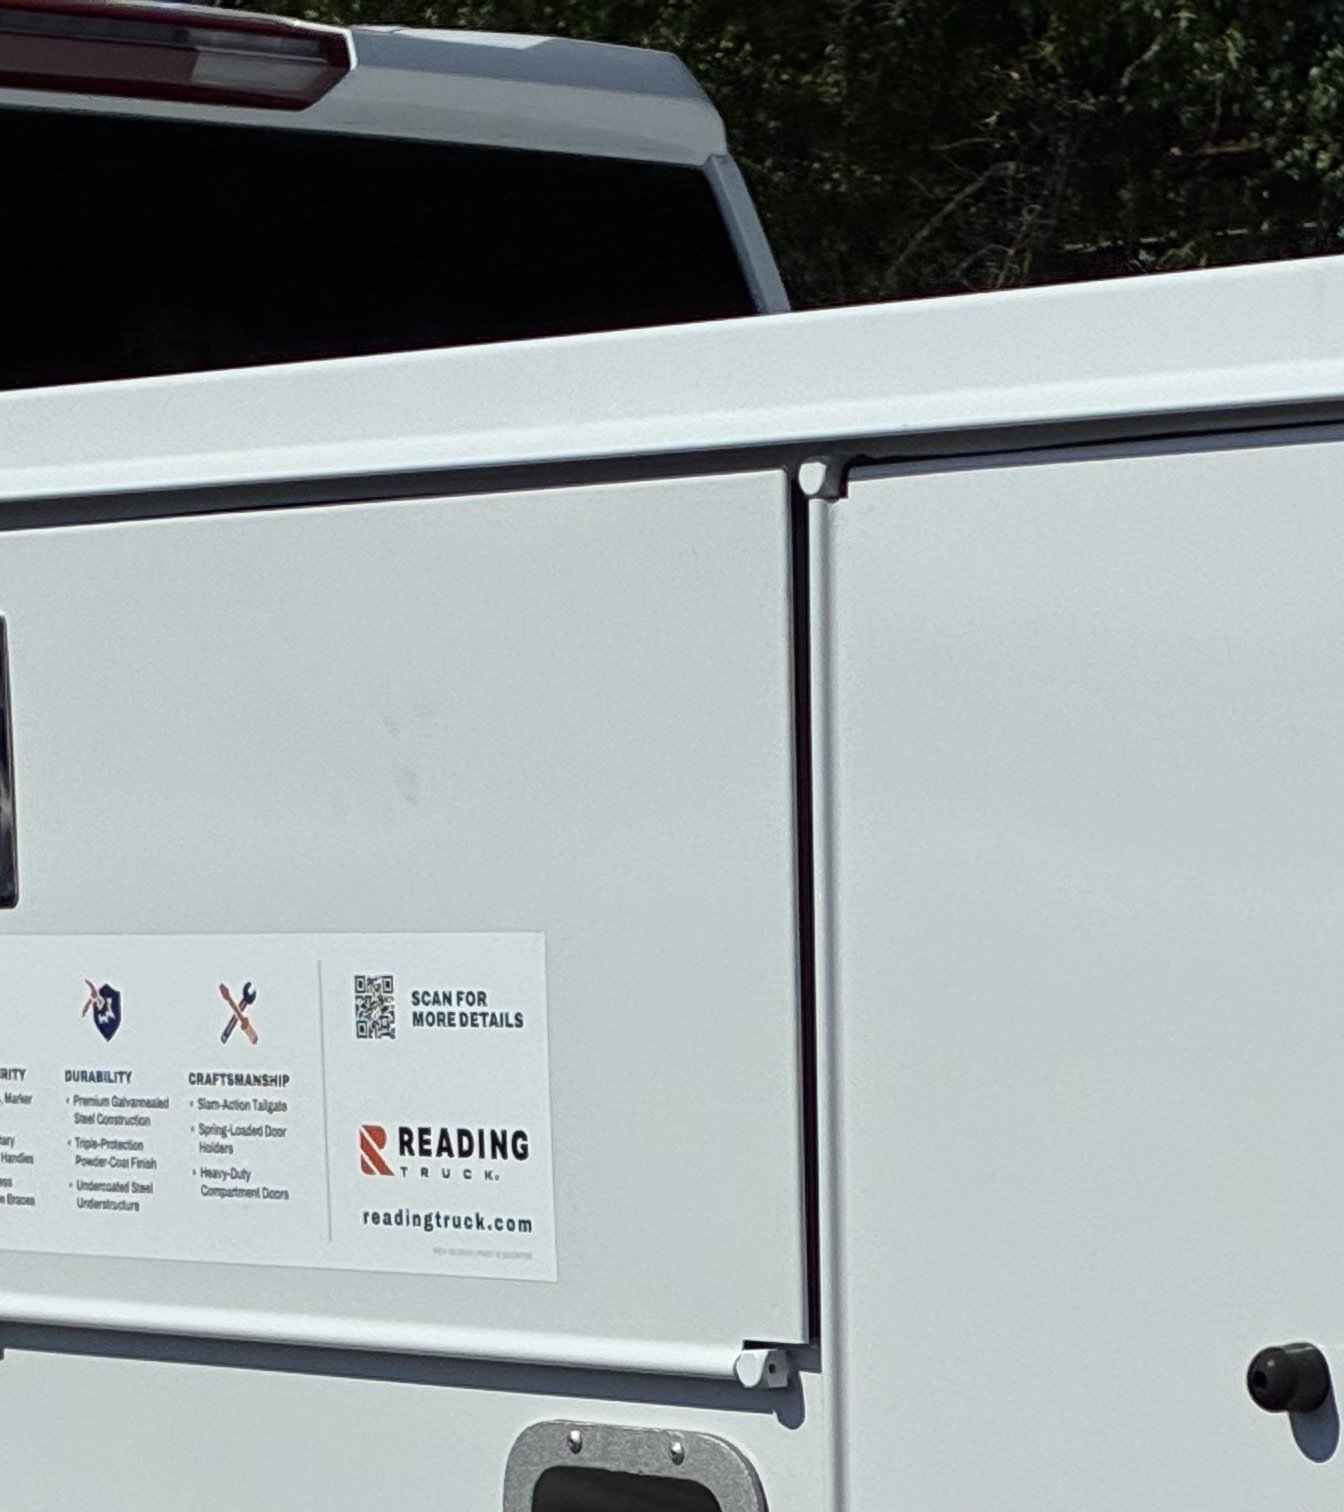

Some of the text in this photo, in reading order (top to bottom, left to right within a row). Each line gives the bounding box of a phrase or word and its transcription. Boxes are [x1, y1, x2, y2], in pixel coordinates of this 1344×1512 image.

[411, 991, 488, 1007] SCAN FOR
[412, 1011, 524, 1028] MORE DETAILS
[64, 1070, 132, 1084] DURABILITY
[188, 1072, 290, 1088] CRAFTSMANSHIP
[398, 1126, 529, 1161] READING
[362, 1208, 533, 1233] readingtruck.com
